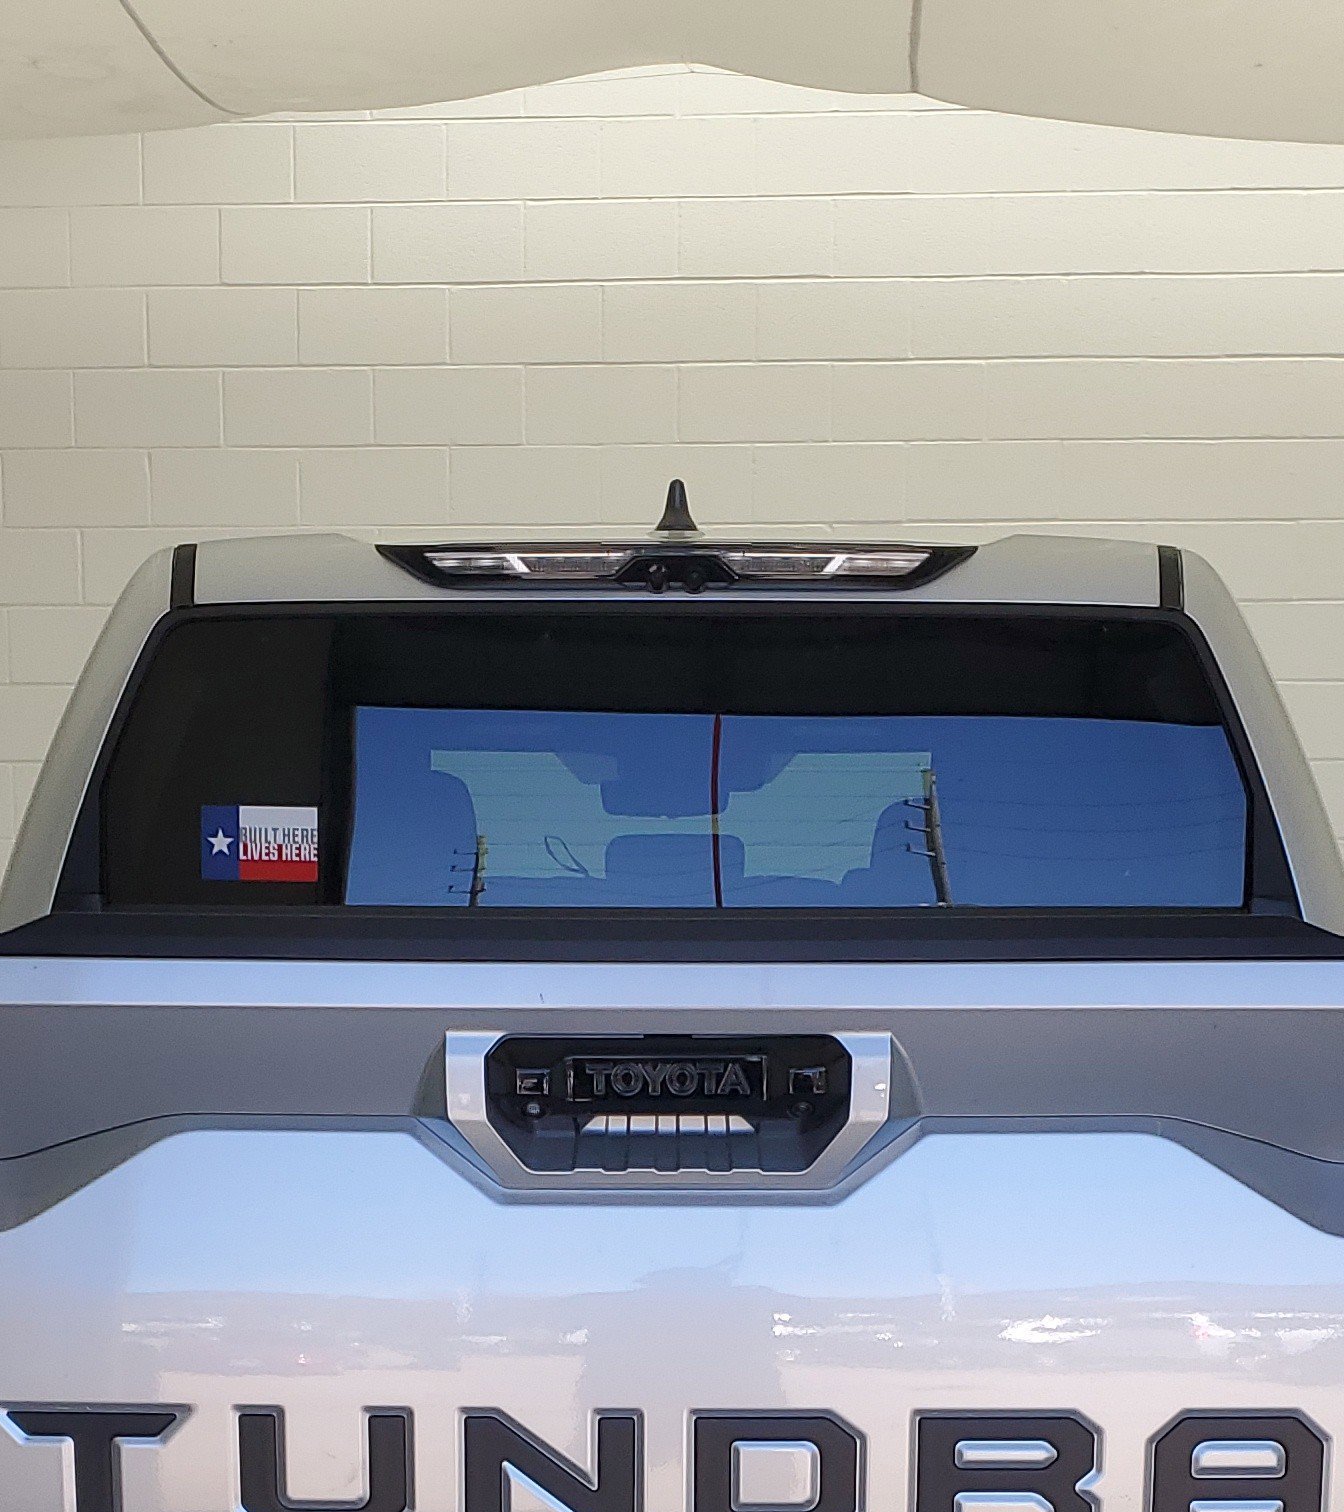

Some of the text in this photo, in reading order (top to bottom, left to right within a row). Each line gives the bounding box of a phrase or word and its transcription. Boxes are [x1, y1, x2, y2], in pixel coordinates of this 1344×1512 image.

[241, 827, 318, 845] BUILT HERE
[239, 843, 318, 862] LIVES HERE
[585, 1062, 751, 1096] TOYOTA
